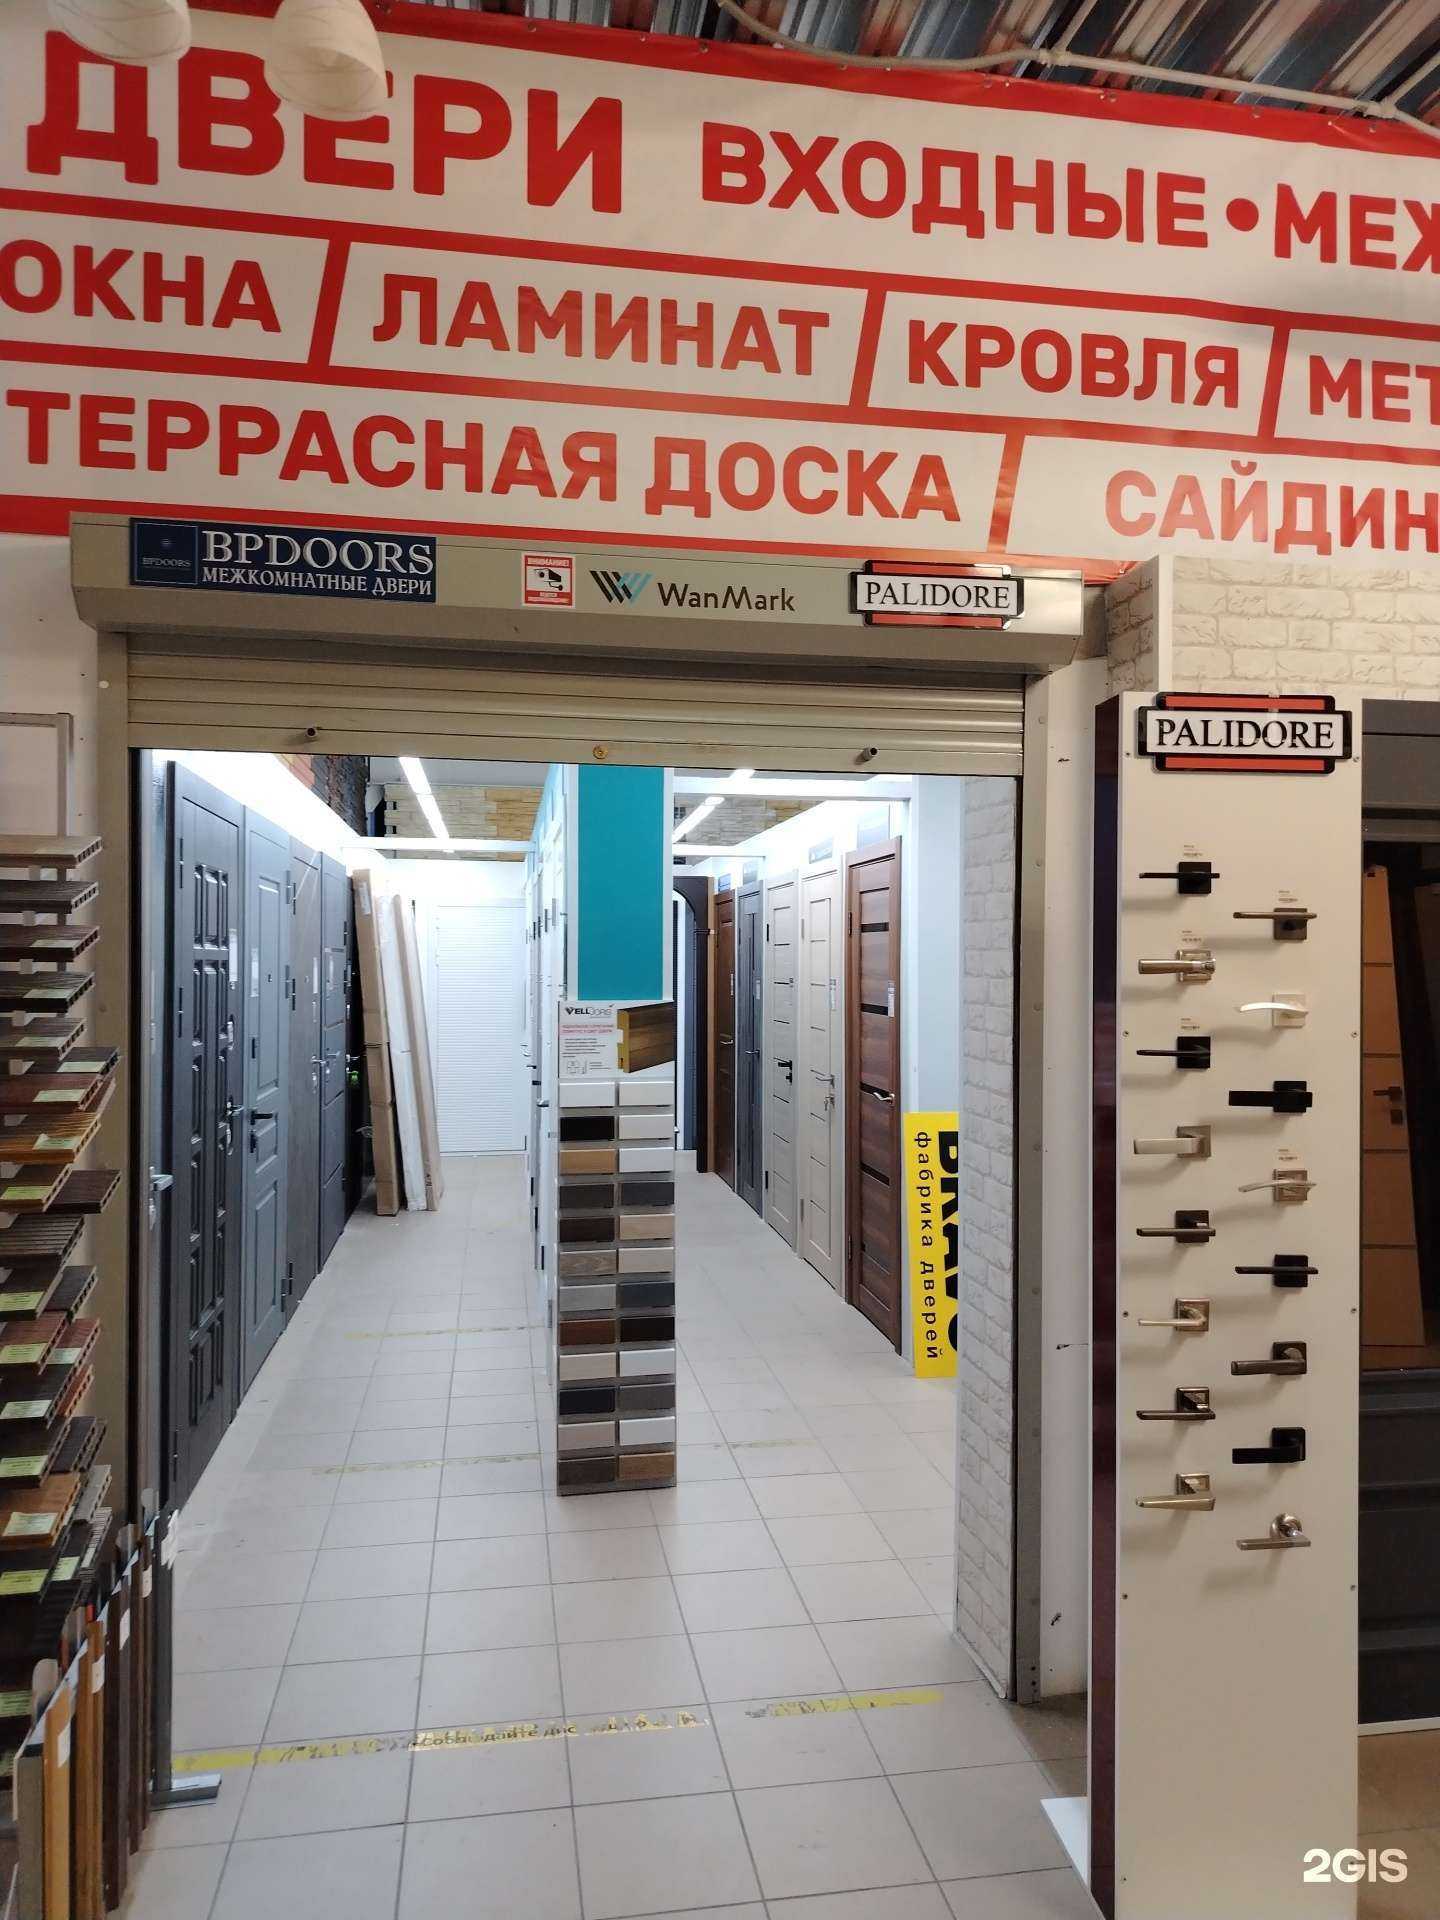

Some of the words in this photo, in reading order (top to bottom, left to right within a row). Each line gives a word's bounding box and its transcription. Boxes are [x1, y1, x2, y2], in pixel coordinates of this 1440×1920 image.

[26, 29, 625, 216] ДВЕРИ
[700, 121, 1211, 251] ВХОДНЫЕ
[0, 238, 282, 336] ОКНА
[372, 273, 832, 377] ЛАМИНАТ
[907, 319, 1241, 412] КРОВЛЯ
[1308, 354, 1440, 427] МЕТ
[6, 388, 618, 503] ТЕРРАСНАЯ
[643, 435, 961, 523] ДОСКА
[202, 530, 434, 576] BPDOORS
[1104, 459, 1440, 558] САЙДИН
[202, 566, 368, 593] МЕЖКОМНАТНЫЕ
[372, 575, 432, 597] ДВЕРИ
[657, 582, 796, 612] WanMark
[865, 581, 1011, 610] PALIDORE
[1156, 717, 1335, 750] PALIDORE
[914, 1131, 935, 1248] фабрика
[920, 1260, 943, 1359] дверей
